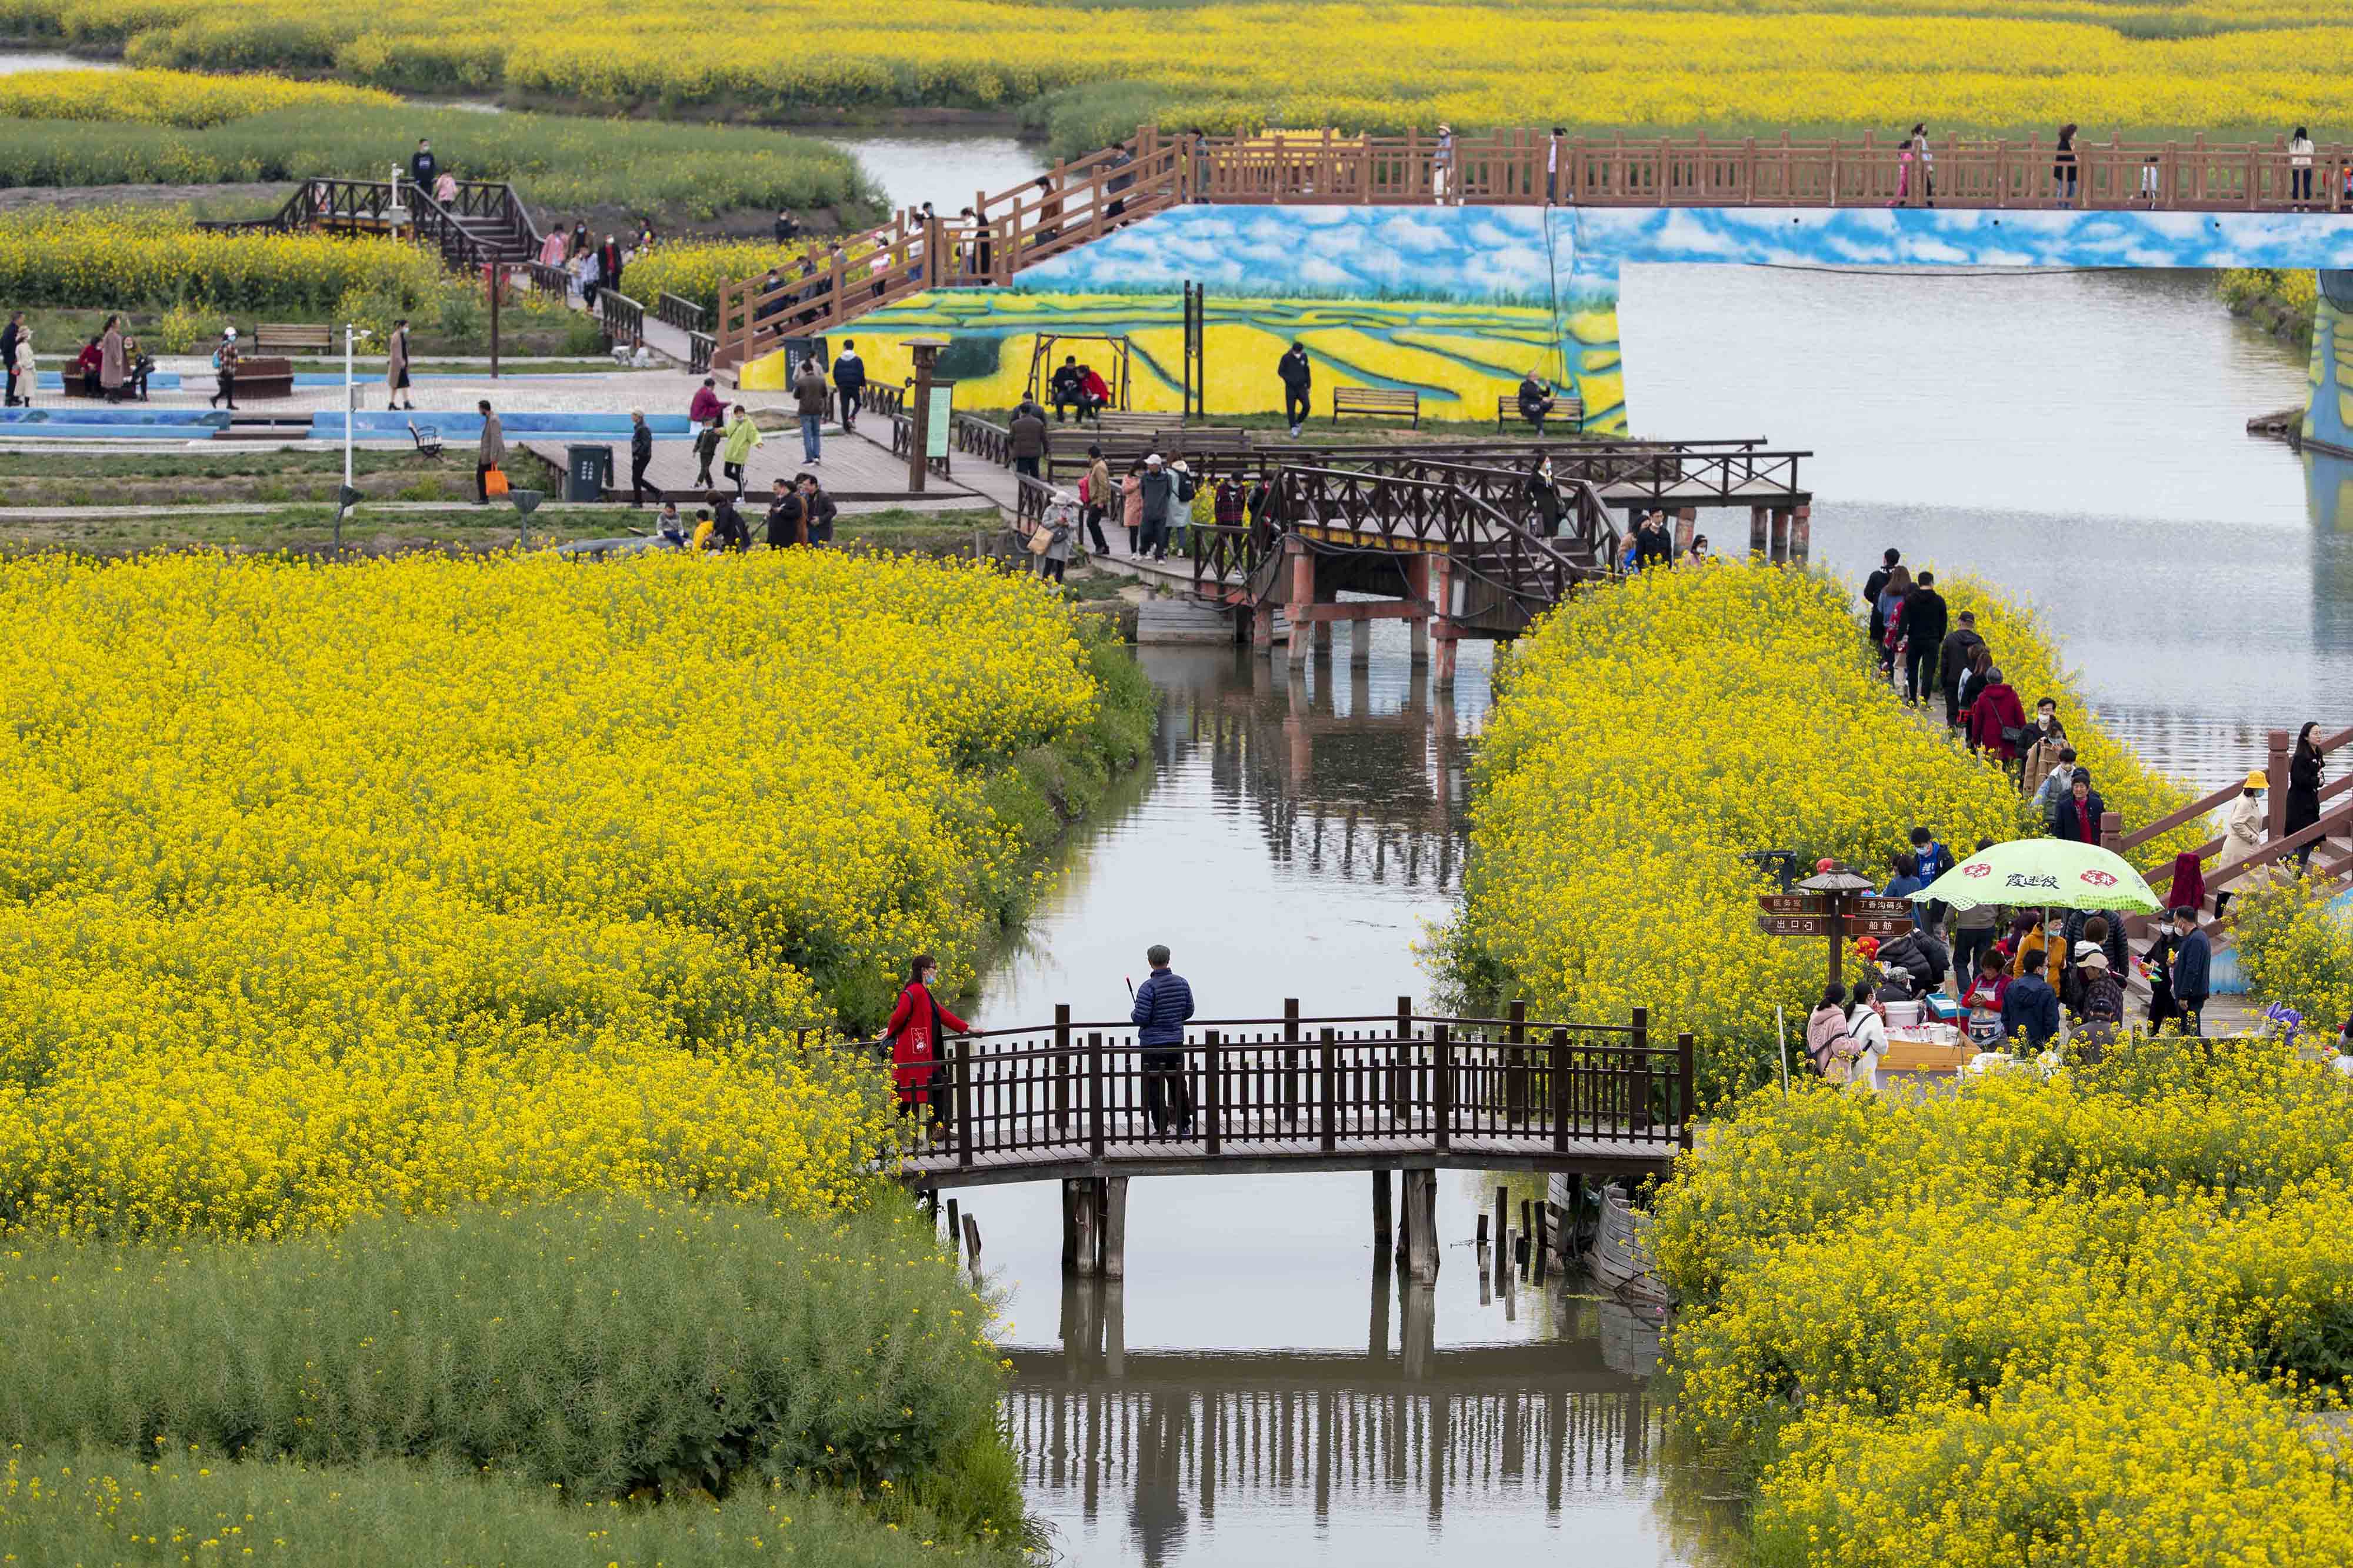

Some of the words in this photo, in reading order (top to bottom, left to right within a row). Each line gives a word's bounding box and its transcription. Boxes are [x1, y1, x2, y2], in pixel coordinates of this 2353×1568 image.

[1774, 899, 1802, 907] 医务室
[1859, 900, 1904, 909] 丁香沟码头
[1777, 919, 1799, 929] 出口
[1869, 920, 1892, 930] 船舫
